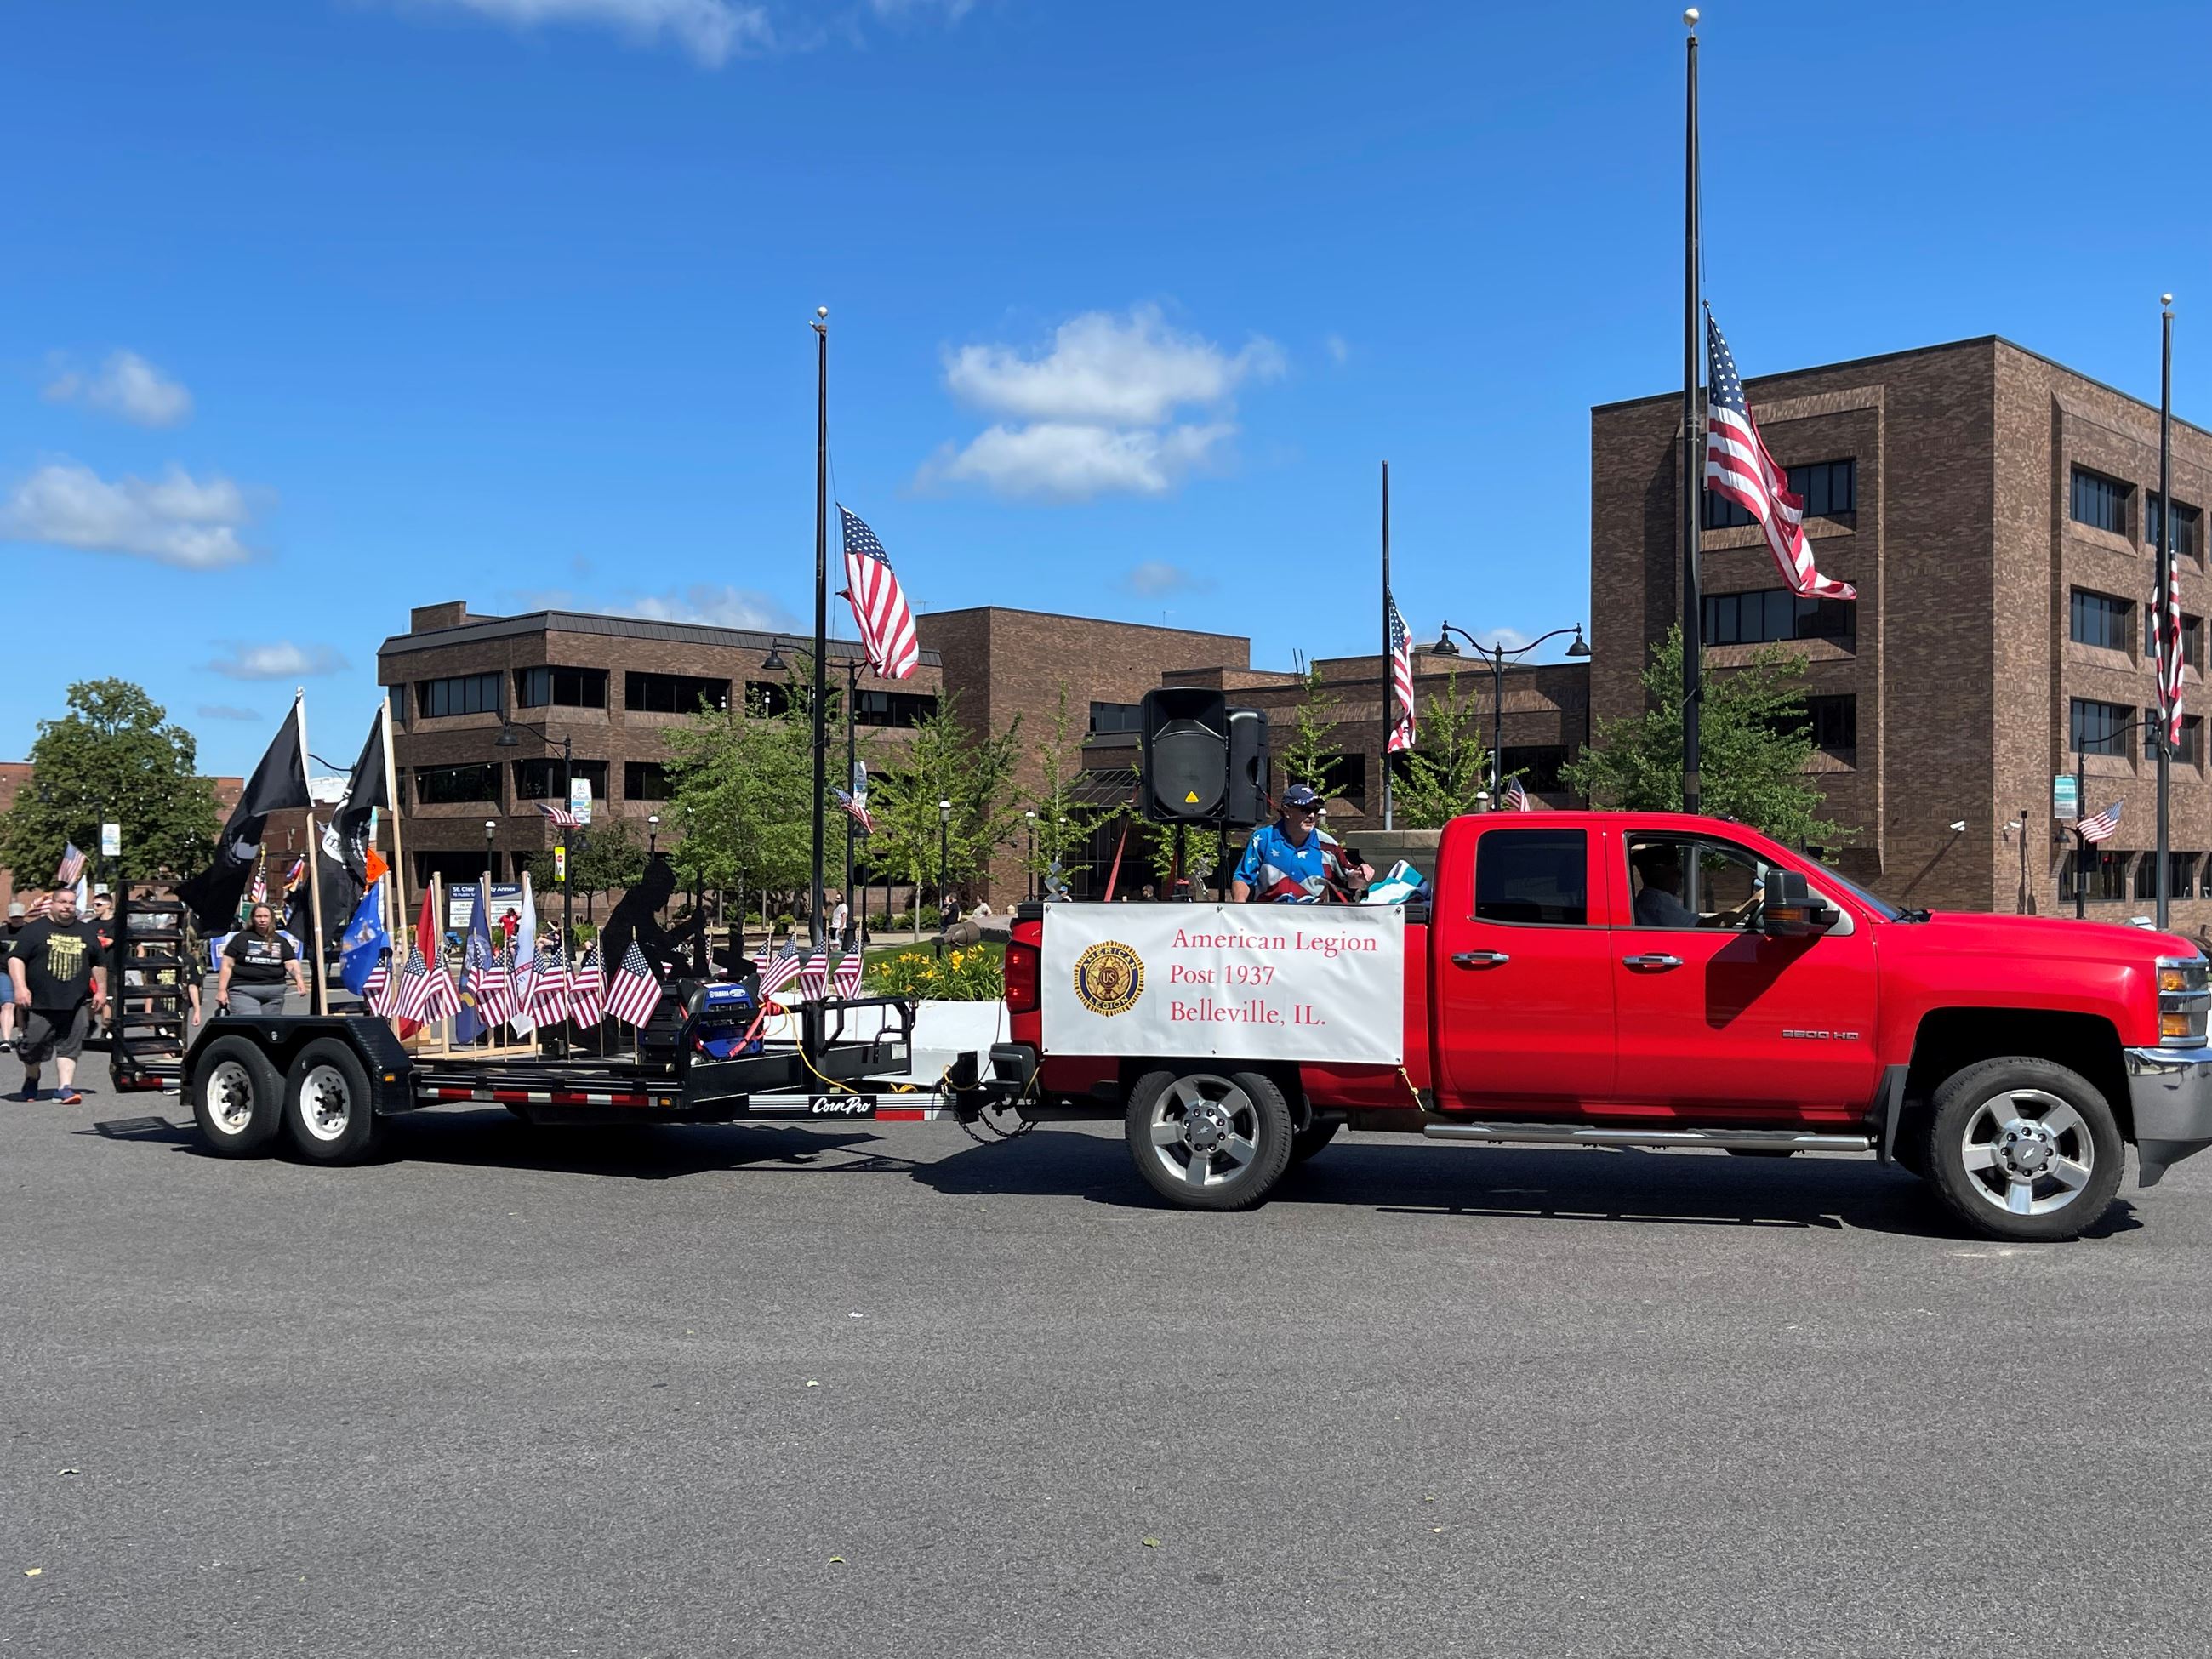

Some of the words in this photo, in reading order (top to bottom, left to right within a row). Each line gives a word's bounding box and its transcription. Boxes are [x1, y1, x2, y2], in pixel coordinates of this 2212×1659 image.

[1172, 928, 1286, 949] American
[1295, 931, 1378, 958] Legion
[1083, 947, 1137, 970] AMERICAN
[1103, 972, 1115, 983] US
[1170, 965, 1216, 984] Post
[1224, 966, 1275, 986] 1937
[1089, 995, 1129, 1010] LEGION
[1171, 998, 1285, 1026] Belleville,
[1293, 1004, 1326, 1026] IL.
[1833, 1031, 1859, 1040] HD
[812, 1096, 871, 1115] CornPro
